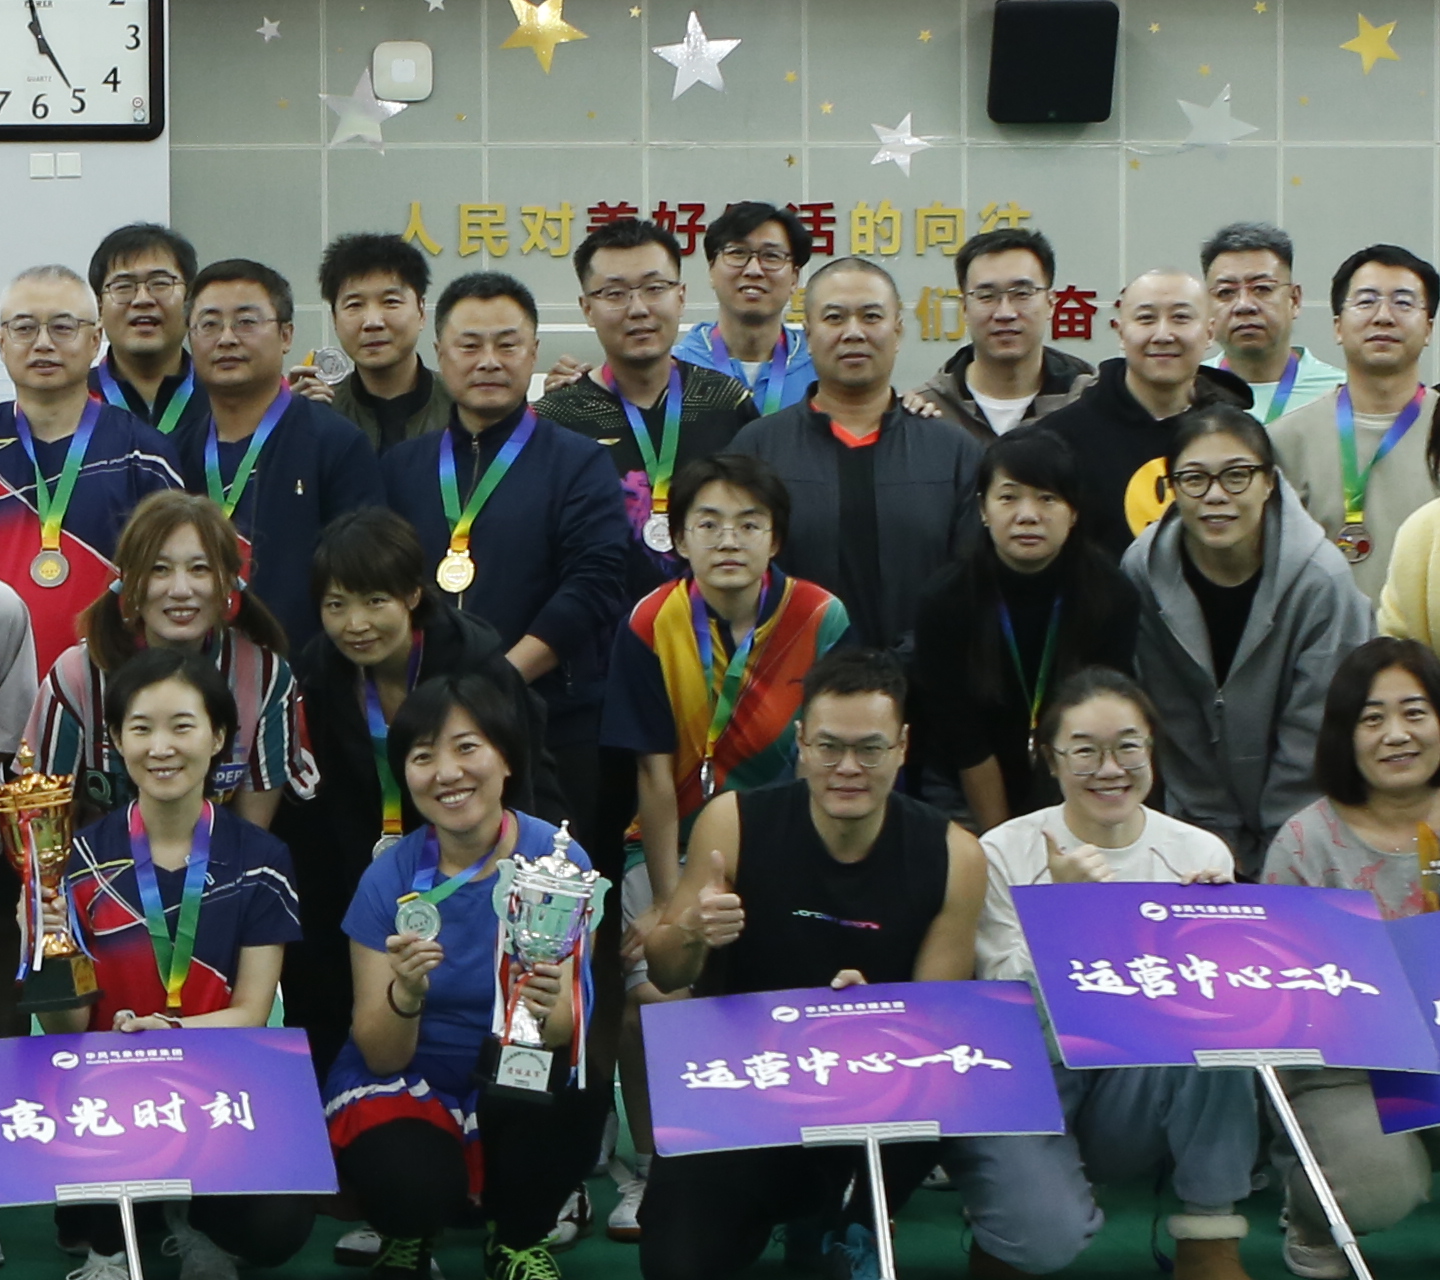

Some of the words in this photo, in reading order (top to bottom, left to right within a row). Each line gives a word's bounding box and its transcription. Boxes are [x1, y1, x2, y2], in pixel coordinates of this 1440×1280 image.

[125, 24, 141, 50] 3
[102, 66, 121, 93] 4
[31, 93, 49, 119] 6
[70, 87, 86, 114] 5
[1068, 953, 1381, 1000] 运营中心二队
[680, 1044, 1013, 1090] 运营中心一队
[0, 1091, 257, 1144] 高光时刻
